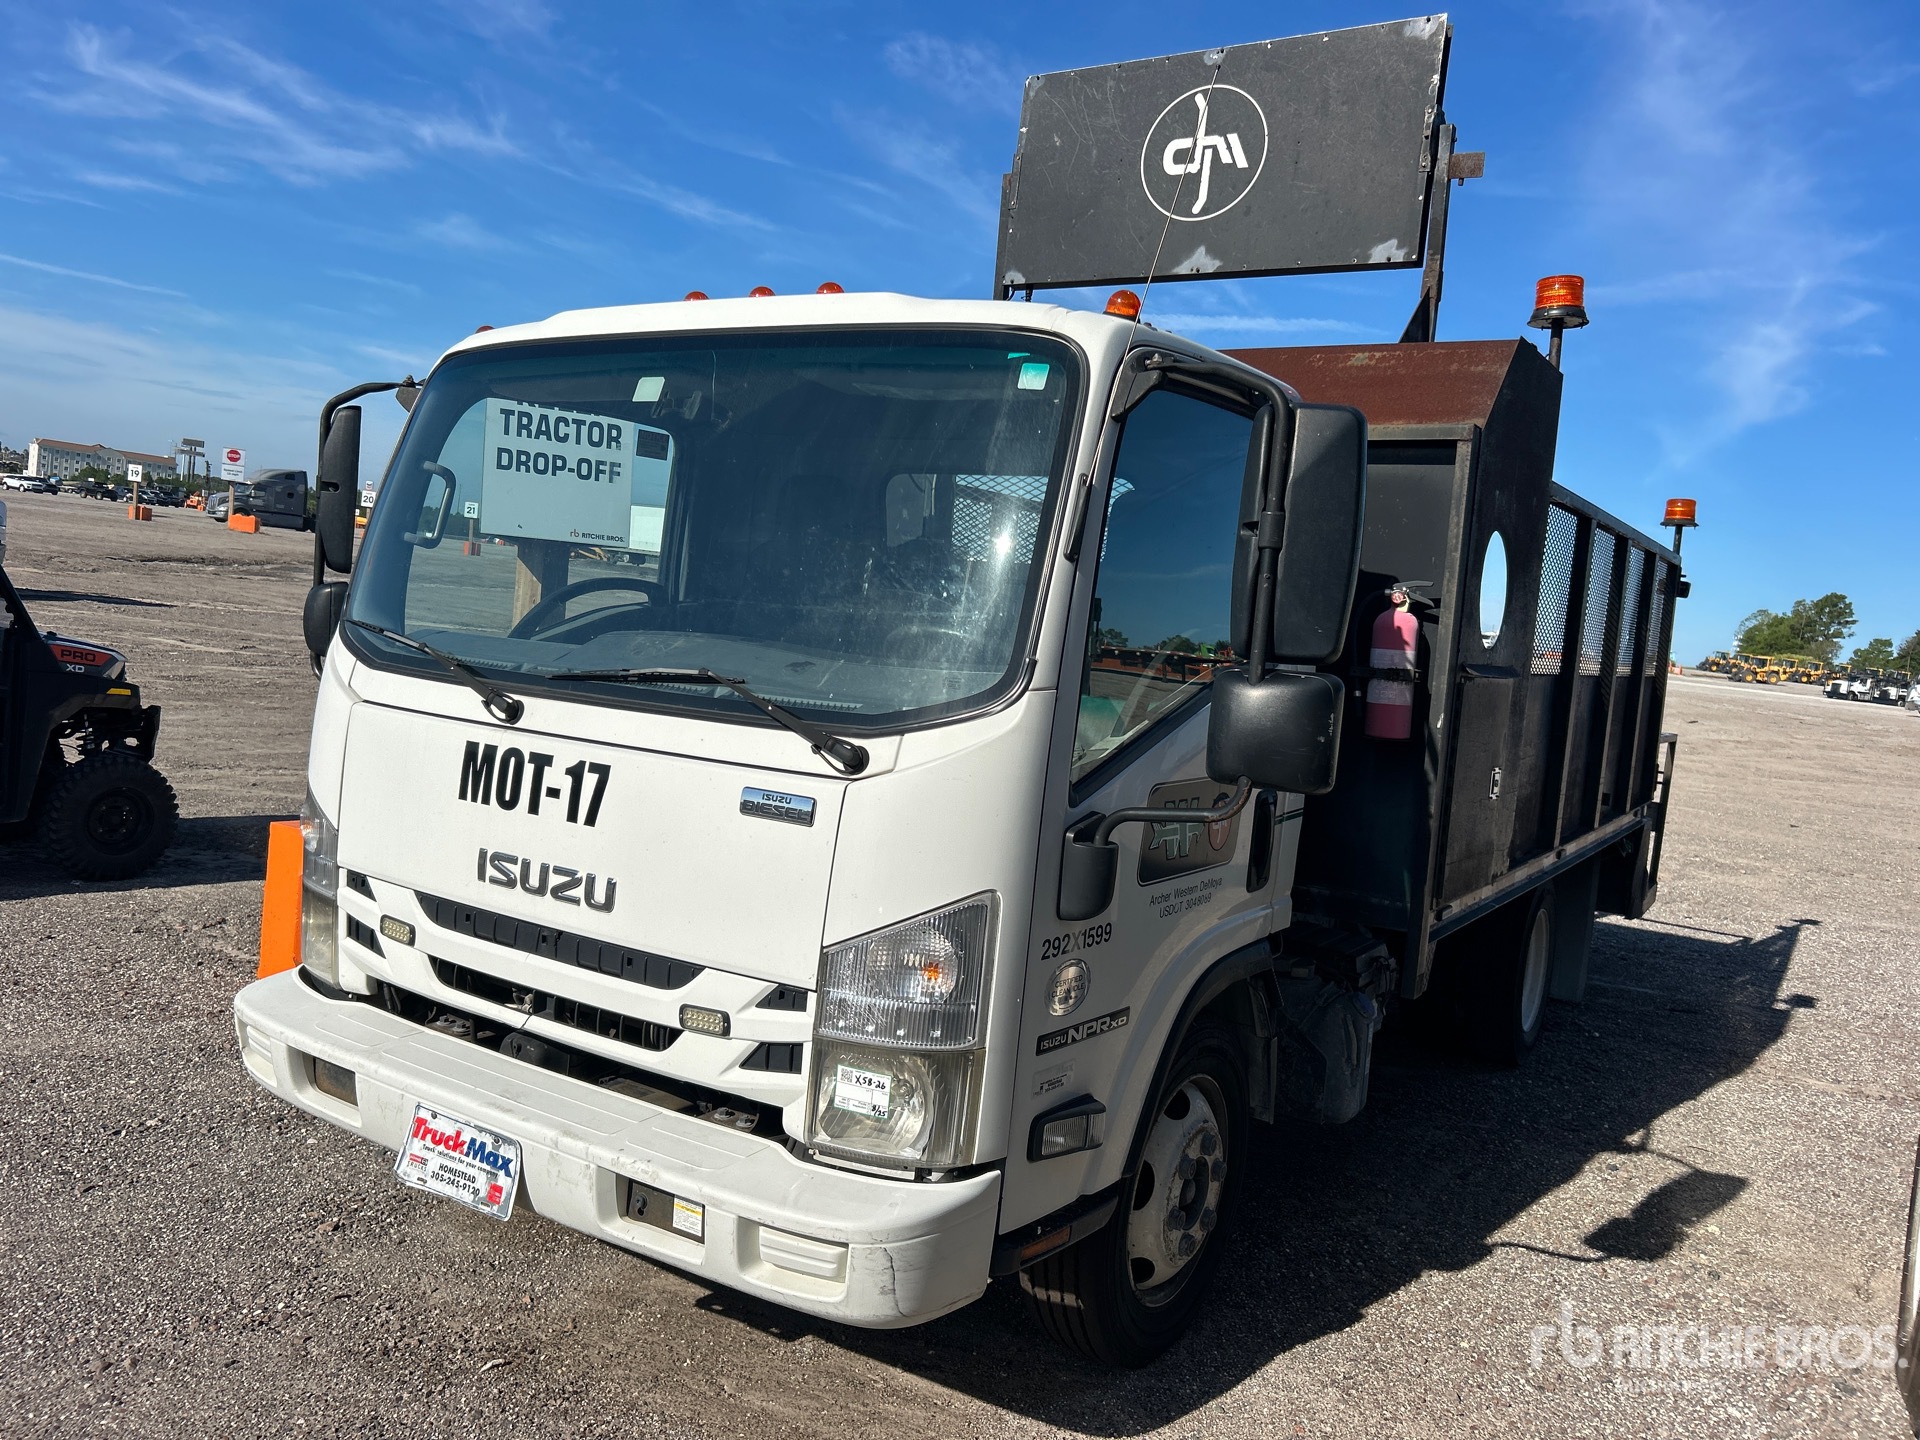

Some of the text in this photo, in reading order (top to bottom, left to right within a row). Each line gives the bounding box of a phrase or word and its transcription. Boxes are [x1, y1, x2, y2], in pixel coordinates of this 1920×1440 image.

[499, 407, 622, 451] TRACTOR
[130, 469, 140, 477] 19
[496, 446, 622, 484] DROP-OFF
[362, 495, 374, 504] 20
[466, 506, 475, 515] 21
[581, 532, 606, 541] RITCHIE
[60, 649, 96, 663] PRO
[66, 663, 85, 673] XD
[458, 740, 612, 828] MOT-17
[762, 792, 792, 804] ISUZU
[742, 800, 812, 821] DIESEL
[477, 847, 617, 914] ISUZU
[1149, 892, 1171, 906] Archer
[1173, 884, 1199, 899] Western
[1159, 901, 1183, 918] USDOT
[1041, 922, 1112, 961] 292X1599
[1054, 974, 1083, 989] CERTIFIED
[1051, 987, 1071, 998] CLEAN
[1040, 1033, 1067, 1050] ISUZU
[854, 1074, 886, 1090] X58-26
[411, 1116, 514, 1178] TruckMax
[438, 1162, 477, 1184] HOMESTEAD
